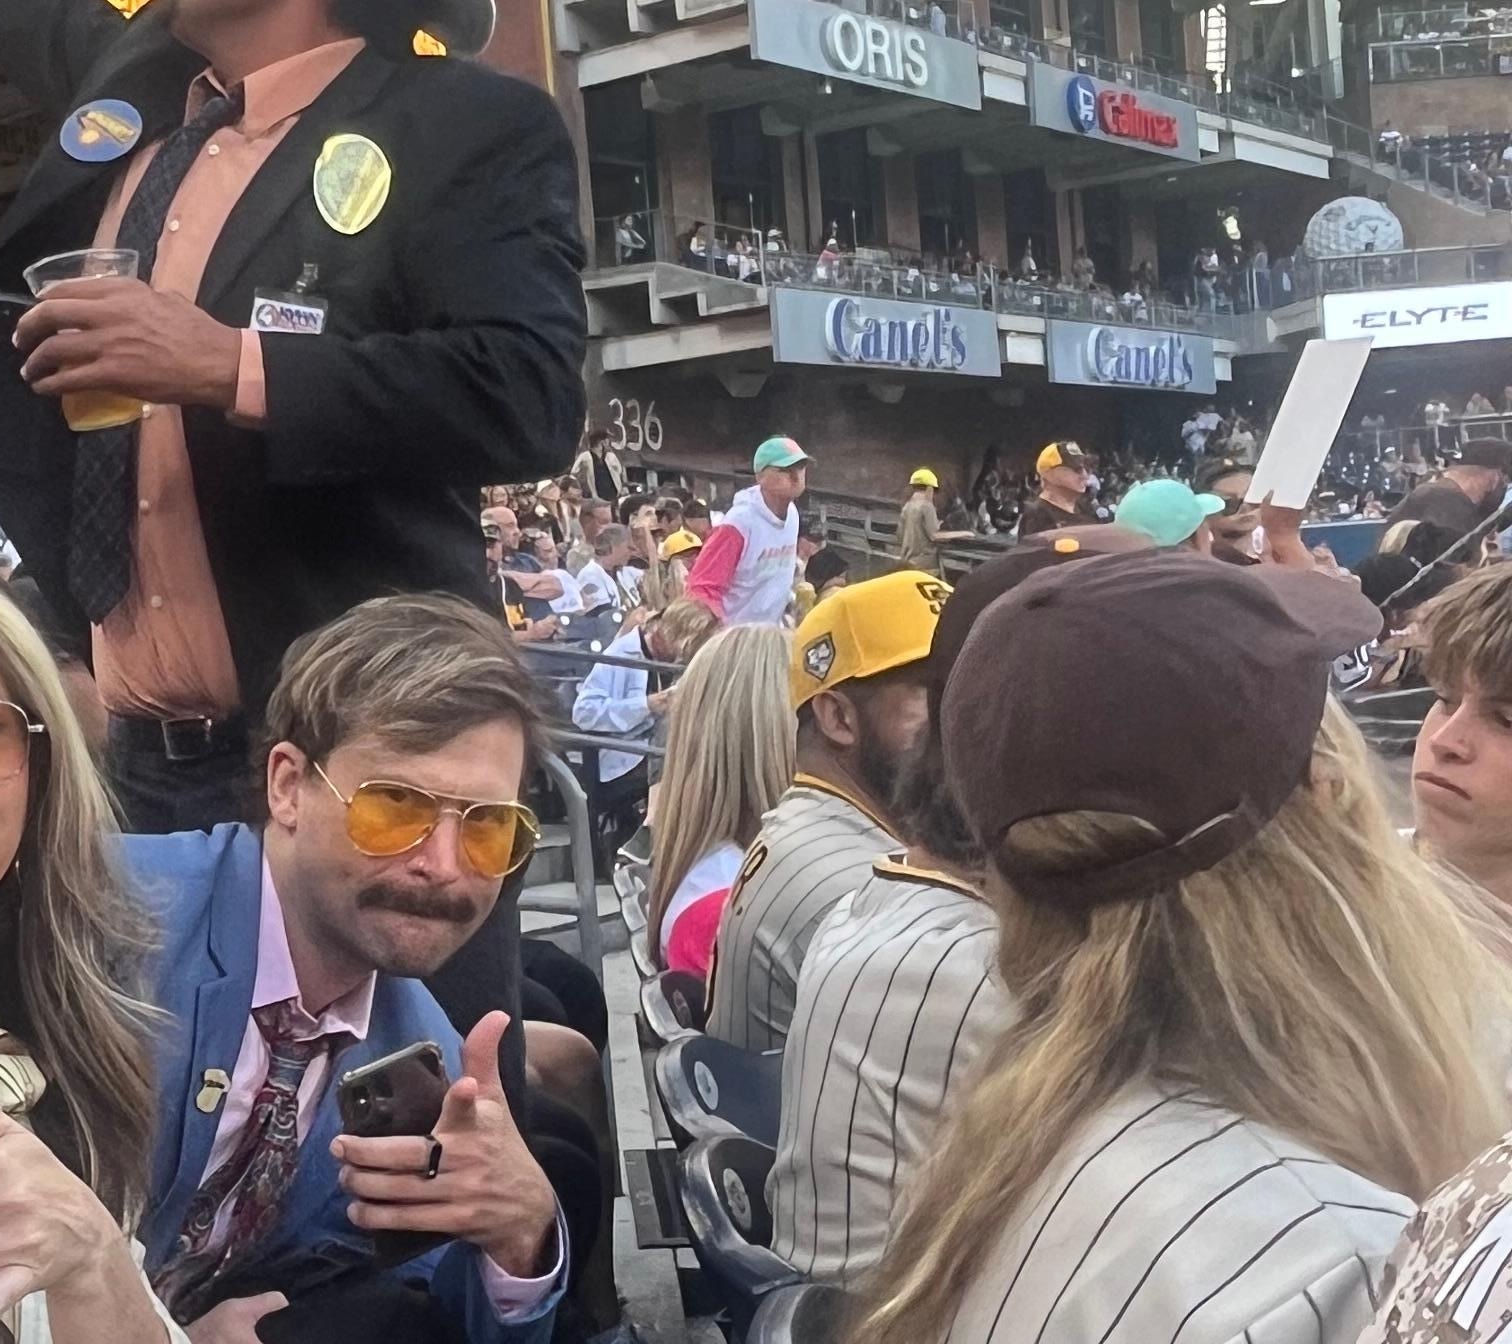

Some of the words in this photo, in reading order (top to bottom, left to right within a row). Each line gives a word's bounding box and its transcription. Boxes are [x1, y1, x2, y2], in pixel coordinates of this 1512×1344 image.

[832, 13, 928, 86] ORIS
[827, 297, 967, 370] Canel's
[608, 398, 663, 451] 336
